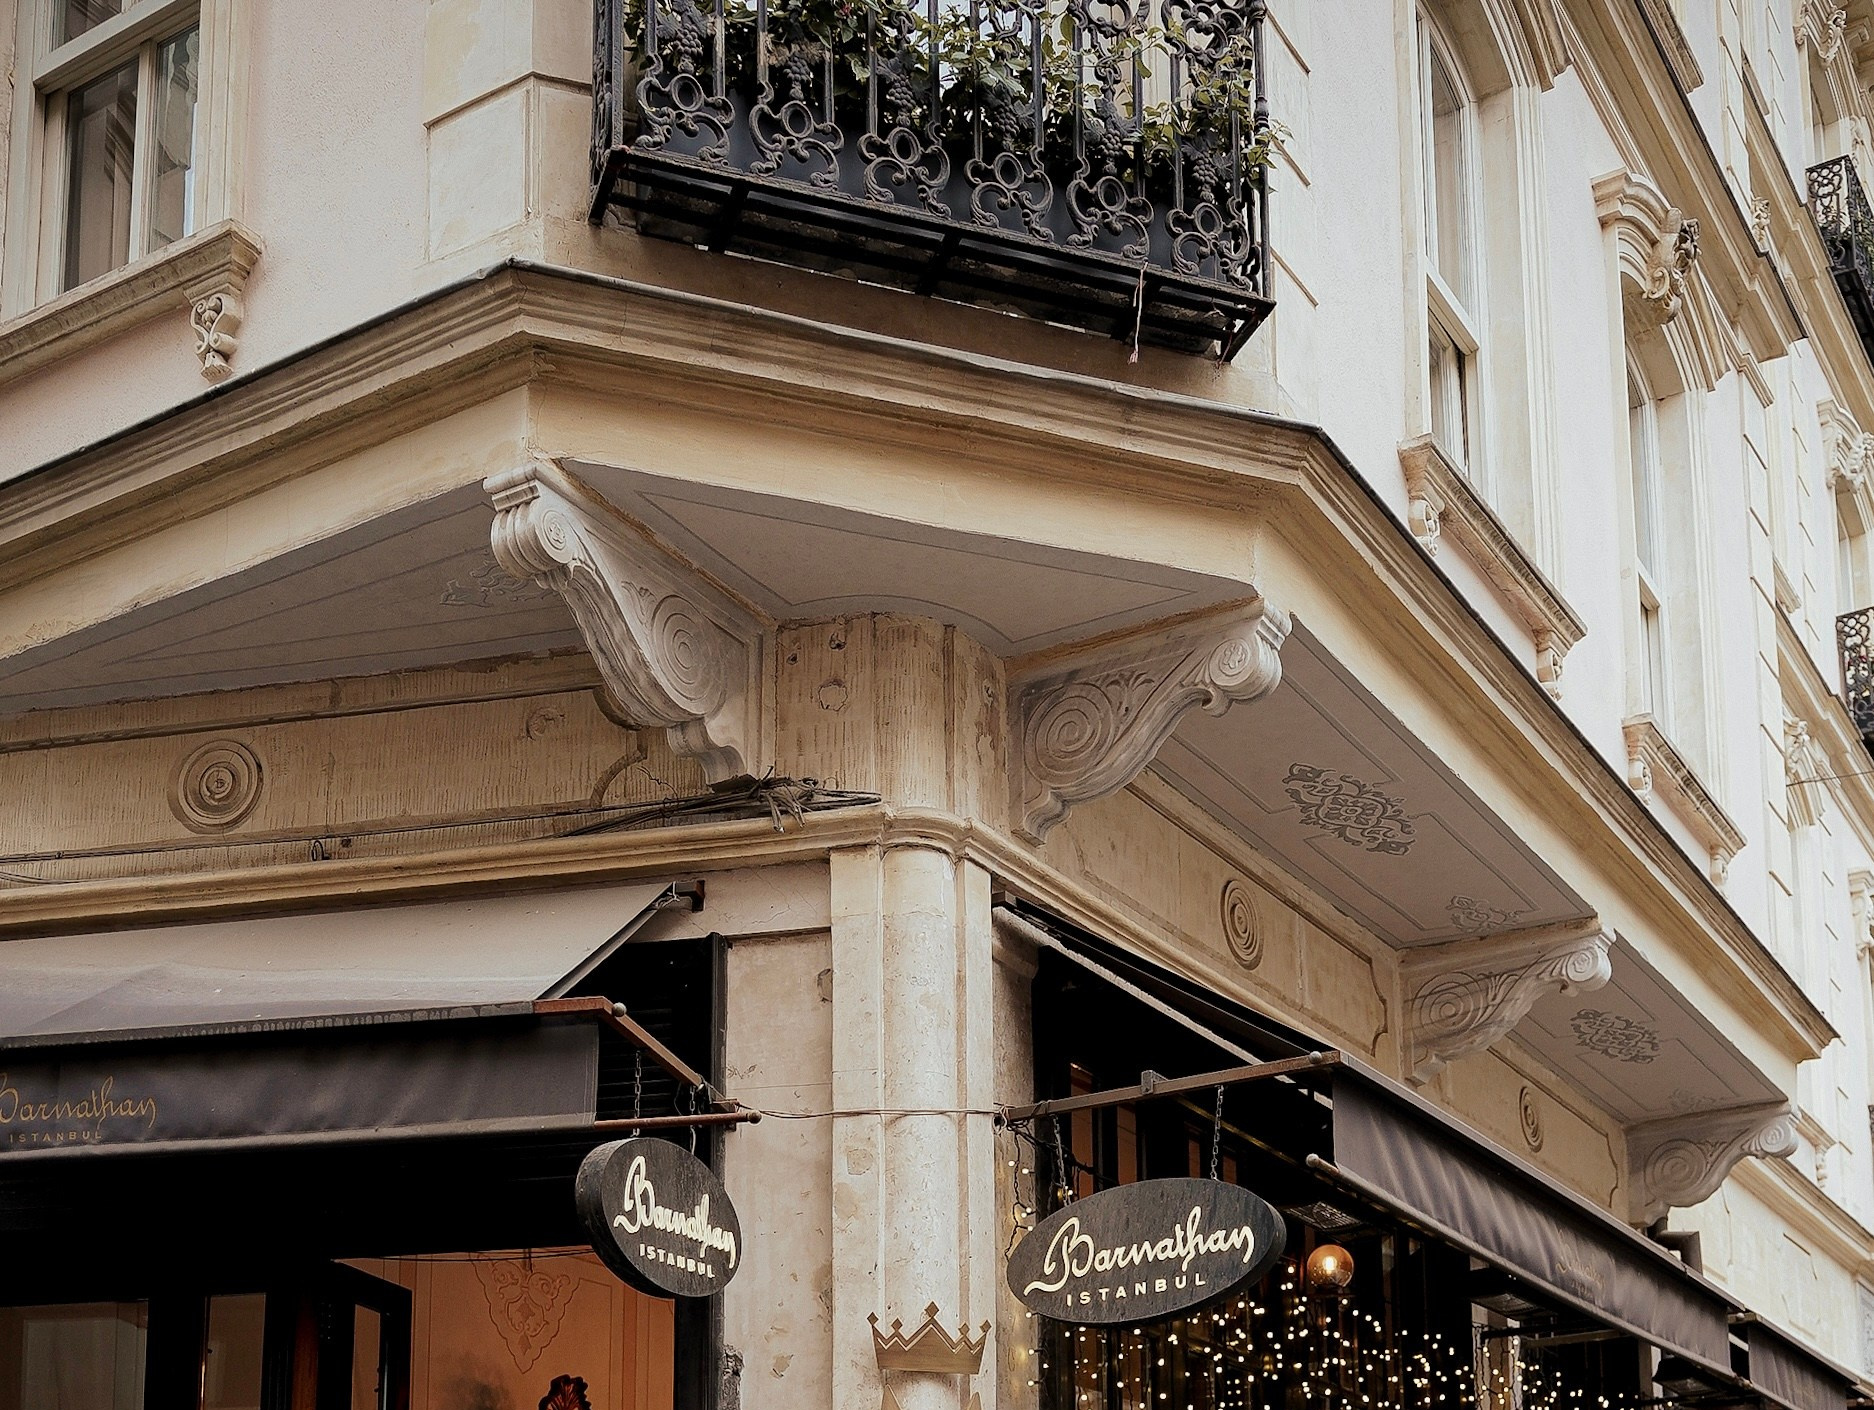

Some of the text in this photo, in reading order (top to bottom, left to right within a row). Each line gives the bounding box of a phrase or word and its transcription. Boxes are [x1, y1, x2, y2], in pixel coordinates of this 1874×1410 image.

[10, 1130, 102, 1143] ISTANBUL
[613, 1155, 737, 1270] Barnathan
[639, 1243, 716, 1278] ISTANBUL
[1023, 1205, 1255, 1297] Barnathan
[1066, 1272, 1207, 1307] ISTANBUL
